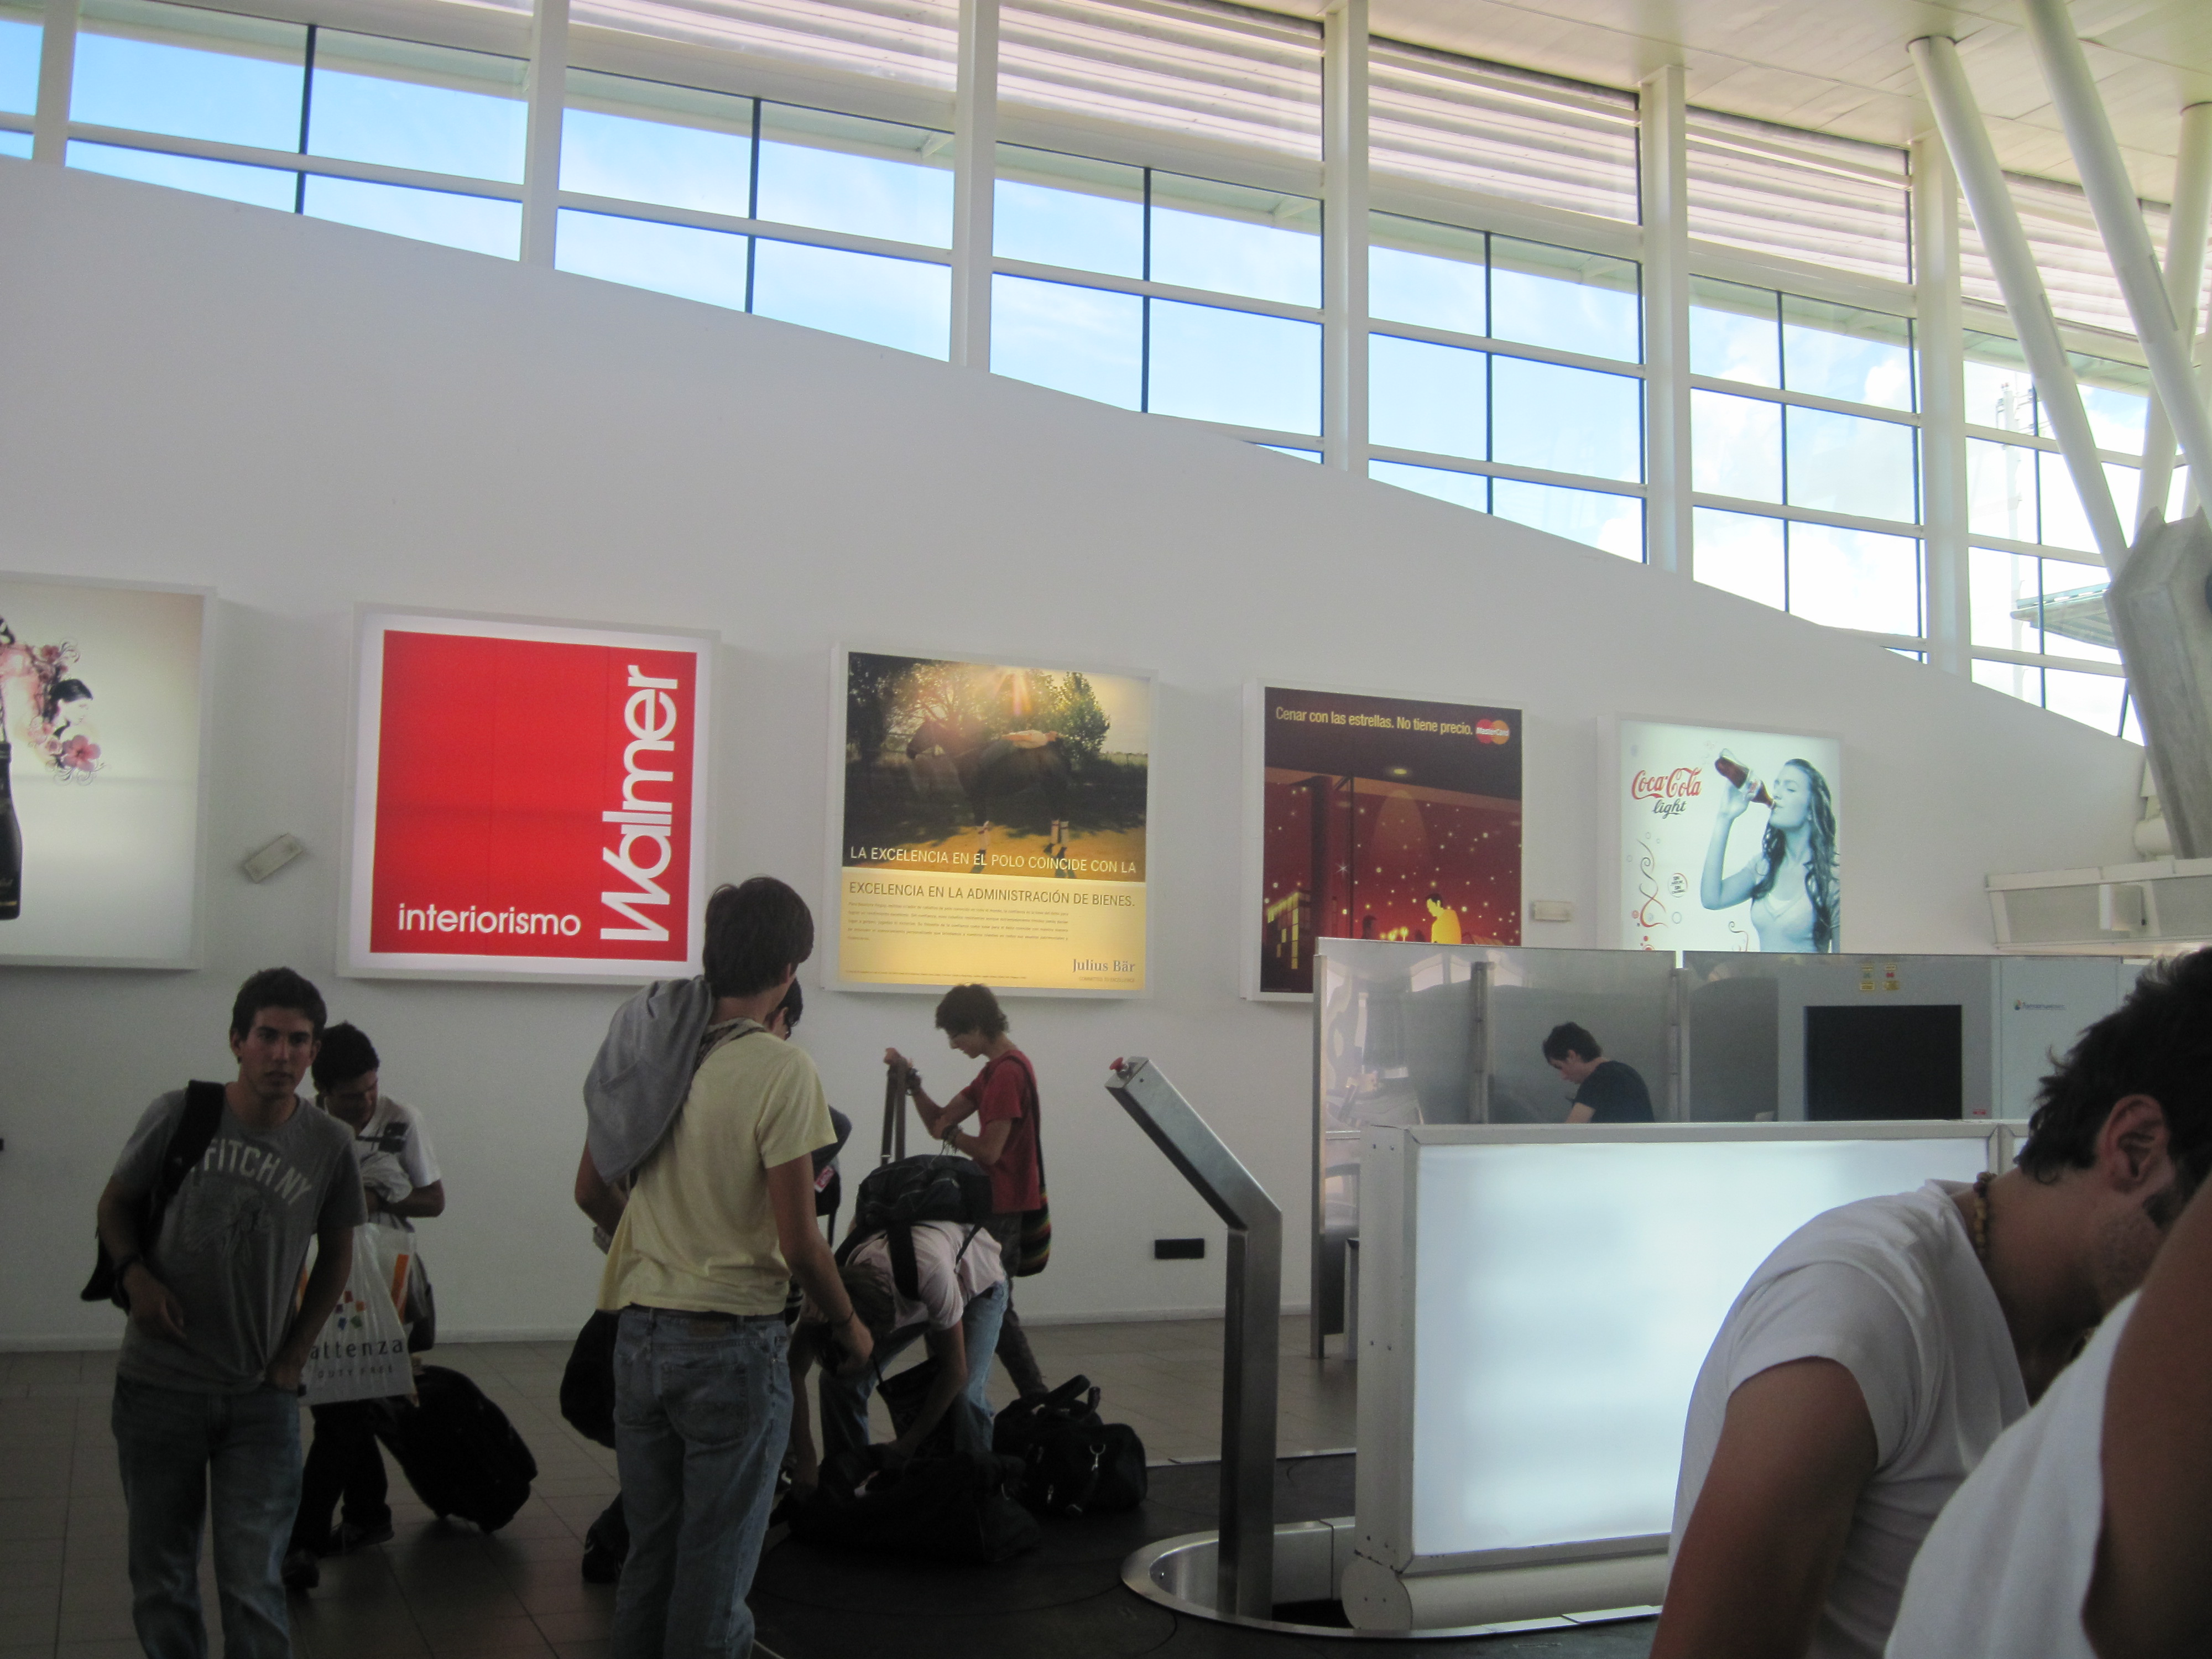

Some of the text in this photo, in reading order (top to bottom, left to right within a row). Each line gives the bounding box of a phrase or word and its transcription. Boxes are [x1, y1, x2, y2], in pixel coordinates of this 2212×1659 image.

[1276, 706, 1473, 735] Cenar con las estrellas. No tiene precio.
[1631, 767, 1702, 800] Coca-Cola
[600, 665, 679, 941] Walmer
[1651, 798, 1687, 820] light
[851, 846, 1136, 873] LA EXCELENCIA EN EL POLO COINCIDE CON LA
[849, 881, 1135, 907] EXCELENCIA EN LA ADMINISTRACIÓN DE BIENES.
[398, 902, 581, 936] interiorismo
[1072, 958, 1135, 973] Julius Bär
[204, 1138, 312, 1207] FITCH NY
[310, 1339, 404, 1360] attenza
[317, 1364, 393, 1379] DUTY FREE
